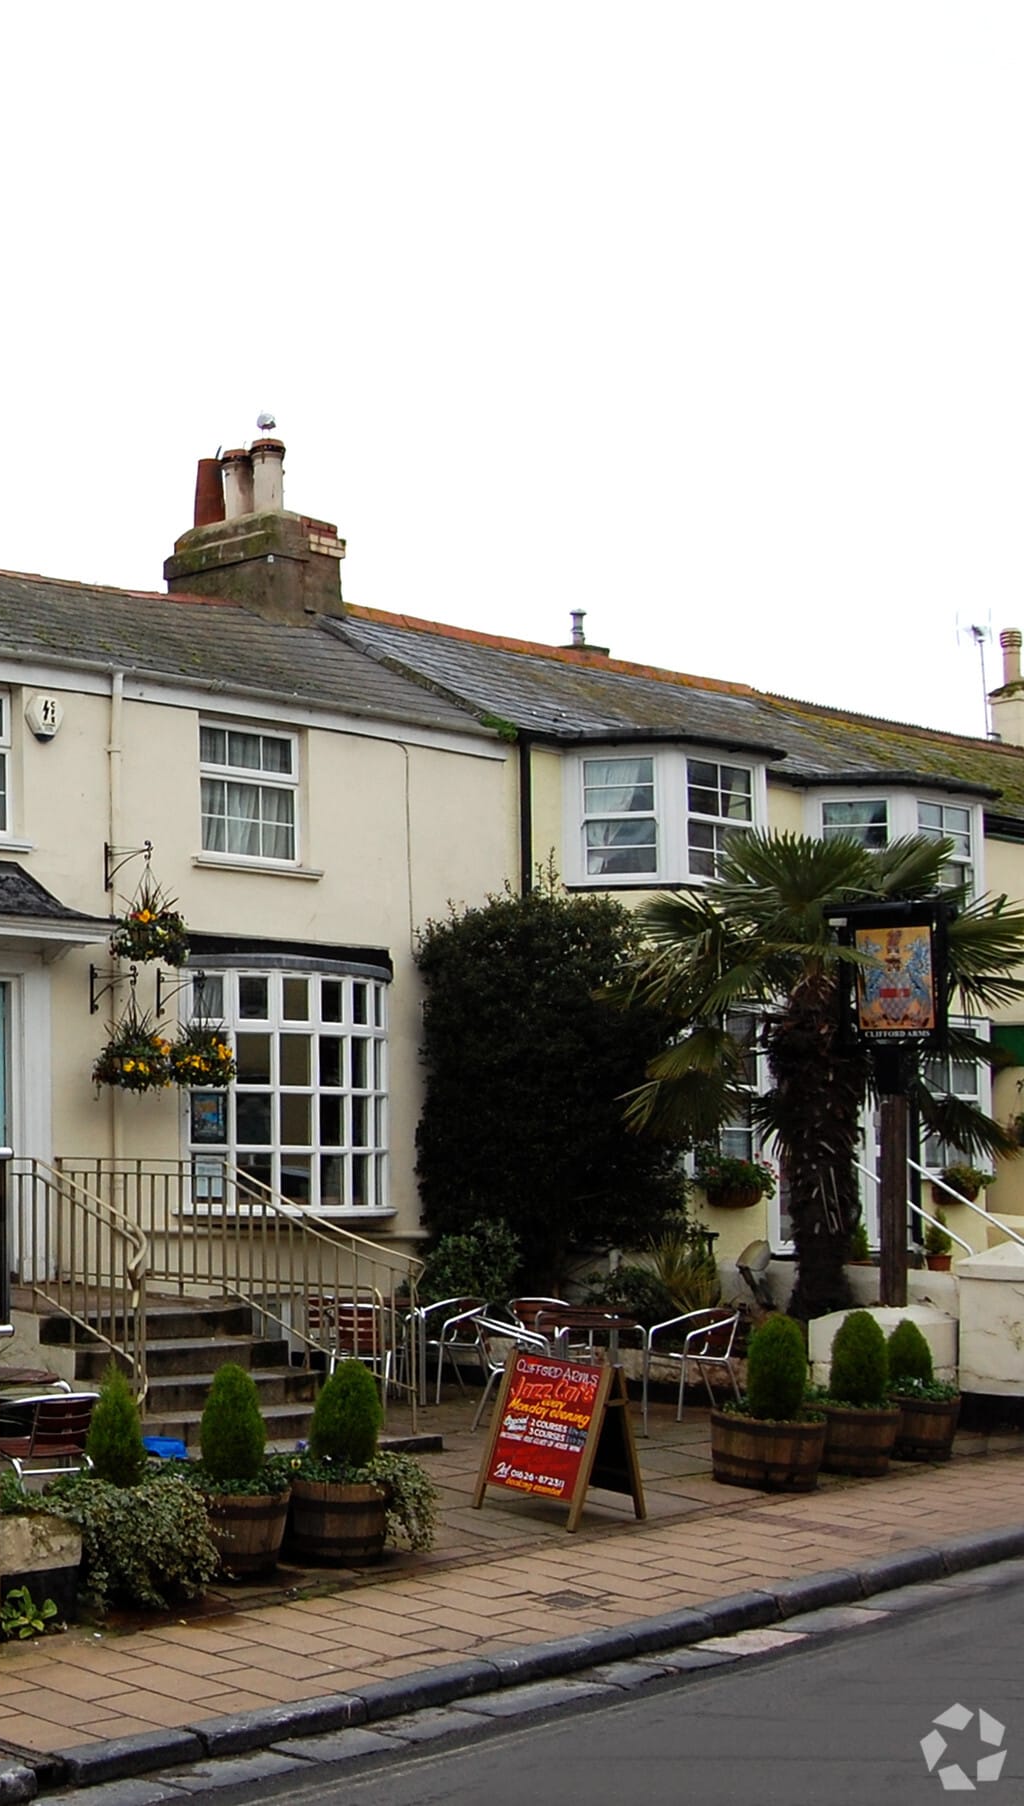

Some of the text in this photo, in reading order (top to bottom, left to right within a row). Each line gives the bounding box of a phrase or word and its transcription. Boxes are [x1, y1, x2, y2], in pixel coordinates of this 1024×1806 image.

[864, 1030, 931, 1038] CLIFFORD ARMS
[516, 1359, 600, 1387] CLIFFORD ARMS
[510, 1375, 554, 1399] Jazz
[541, 1398, 567, 1410] every
[507, 1397, 591, 1429] Monday evening
[530, 1418, 536, 1427] 2
[536, 1419, 568, 1433] COURSES
[534, 1428, 566, 1442] COURSES
